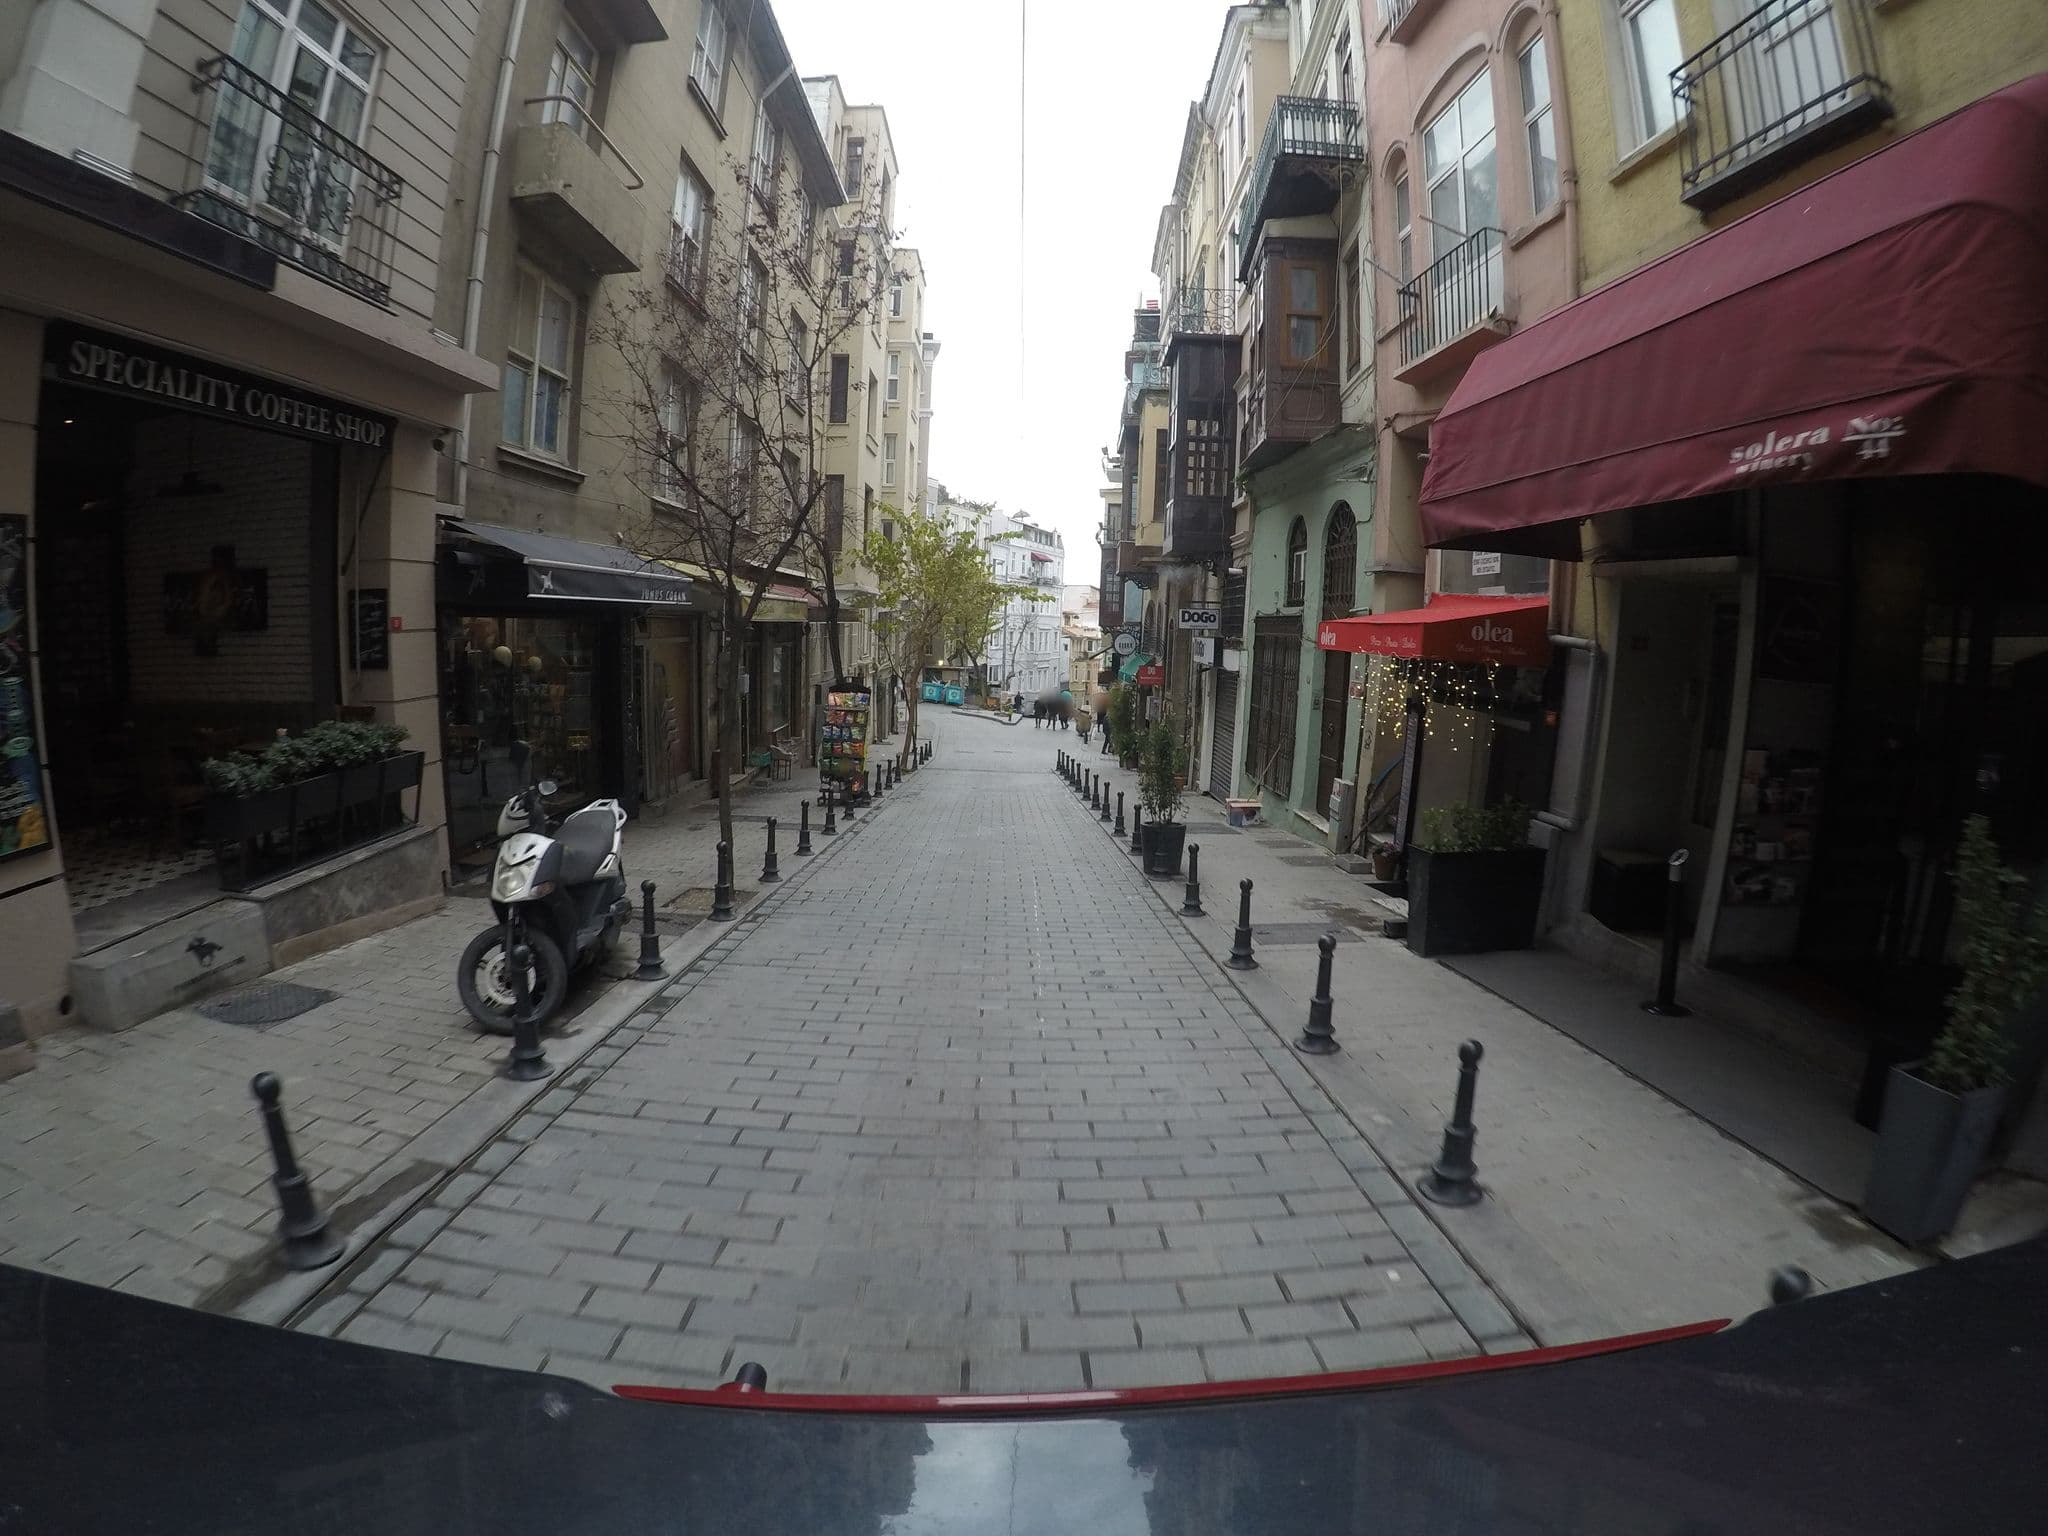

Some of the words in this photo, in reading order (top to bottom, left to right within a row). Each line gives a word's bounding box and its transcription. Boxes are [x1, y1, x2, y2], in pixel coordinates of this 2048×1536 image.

[69, 340, 240, 412] SPECIALITY
[244, 389, 331, 435] COFFEE
[334, 412, 386, 448] SHOP
[1729, 426, 1831, 464] solera
[1320, 625, 1336, 645] olea
[1471, 619, 1514, 643] olea
